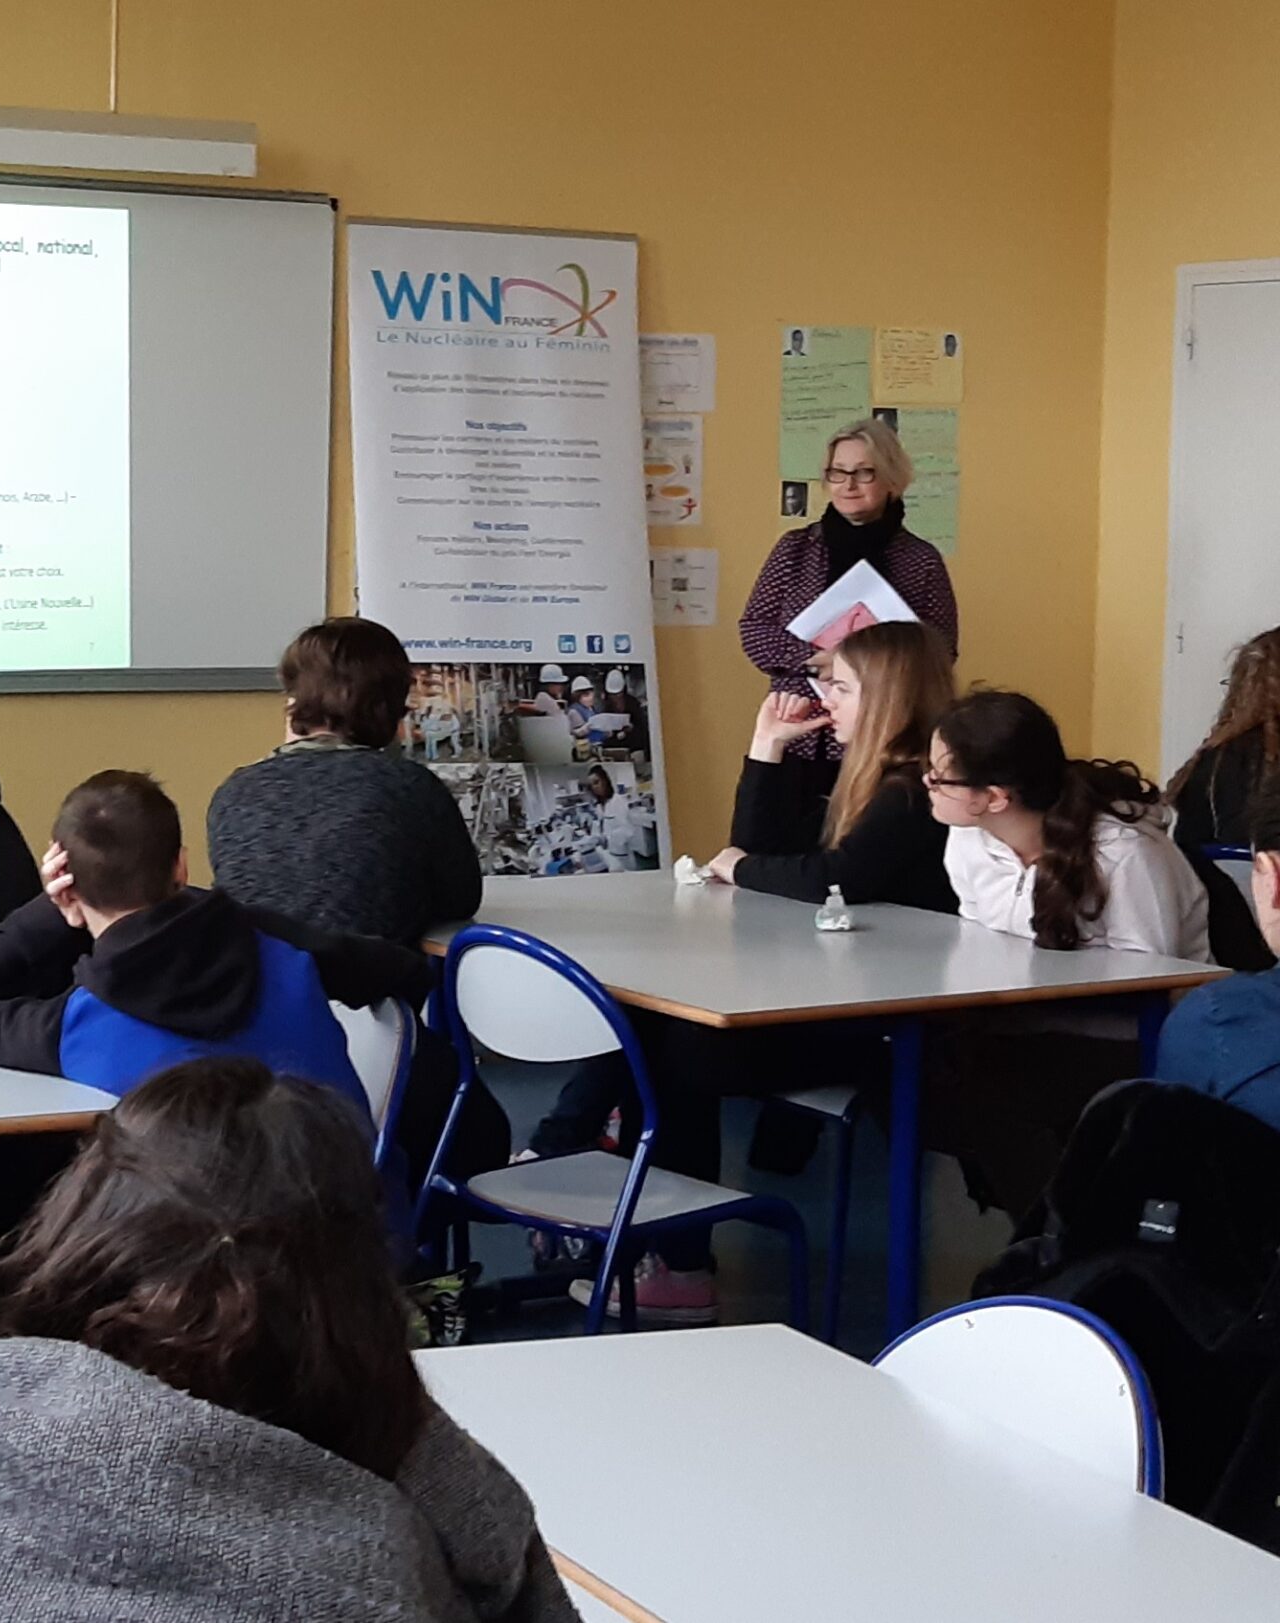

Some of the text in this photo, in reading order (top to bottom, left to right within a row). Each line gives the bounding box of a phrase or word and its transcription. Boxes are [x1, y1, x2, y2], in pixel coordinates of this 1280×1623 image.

[37, 239, 99, 259] national,
[370, 269, 502, 326] WiN
[504, 315, 559, 328] FRANCE
[376, 331, 611, 352] Le Nucléaire au Féminin
[402, 637, 533, 653] www.win-france.org
